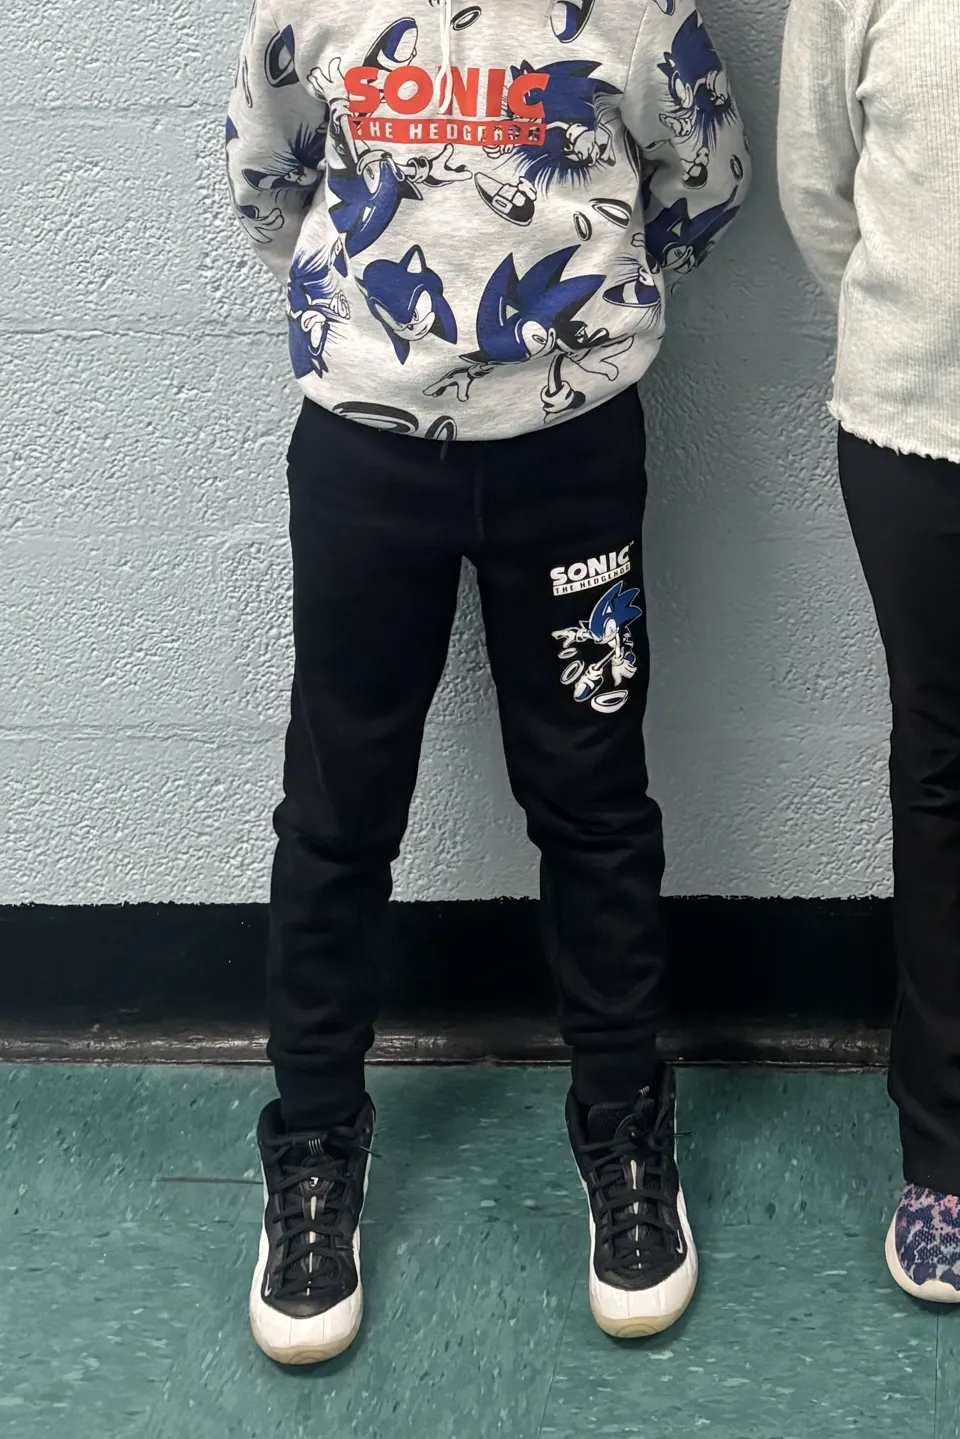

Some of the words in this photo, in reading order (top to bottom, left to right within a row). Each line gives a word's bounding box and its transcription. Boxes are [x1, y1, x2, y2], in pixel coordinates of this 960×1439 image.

[344, 65, 551, 119] SONIC
[353, 121, 393, 139] THE
[550, 545, 630, 586] SONIC
[555, 585, 575, 595] THE
